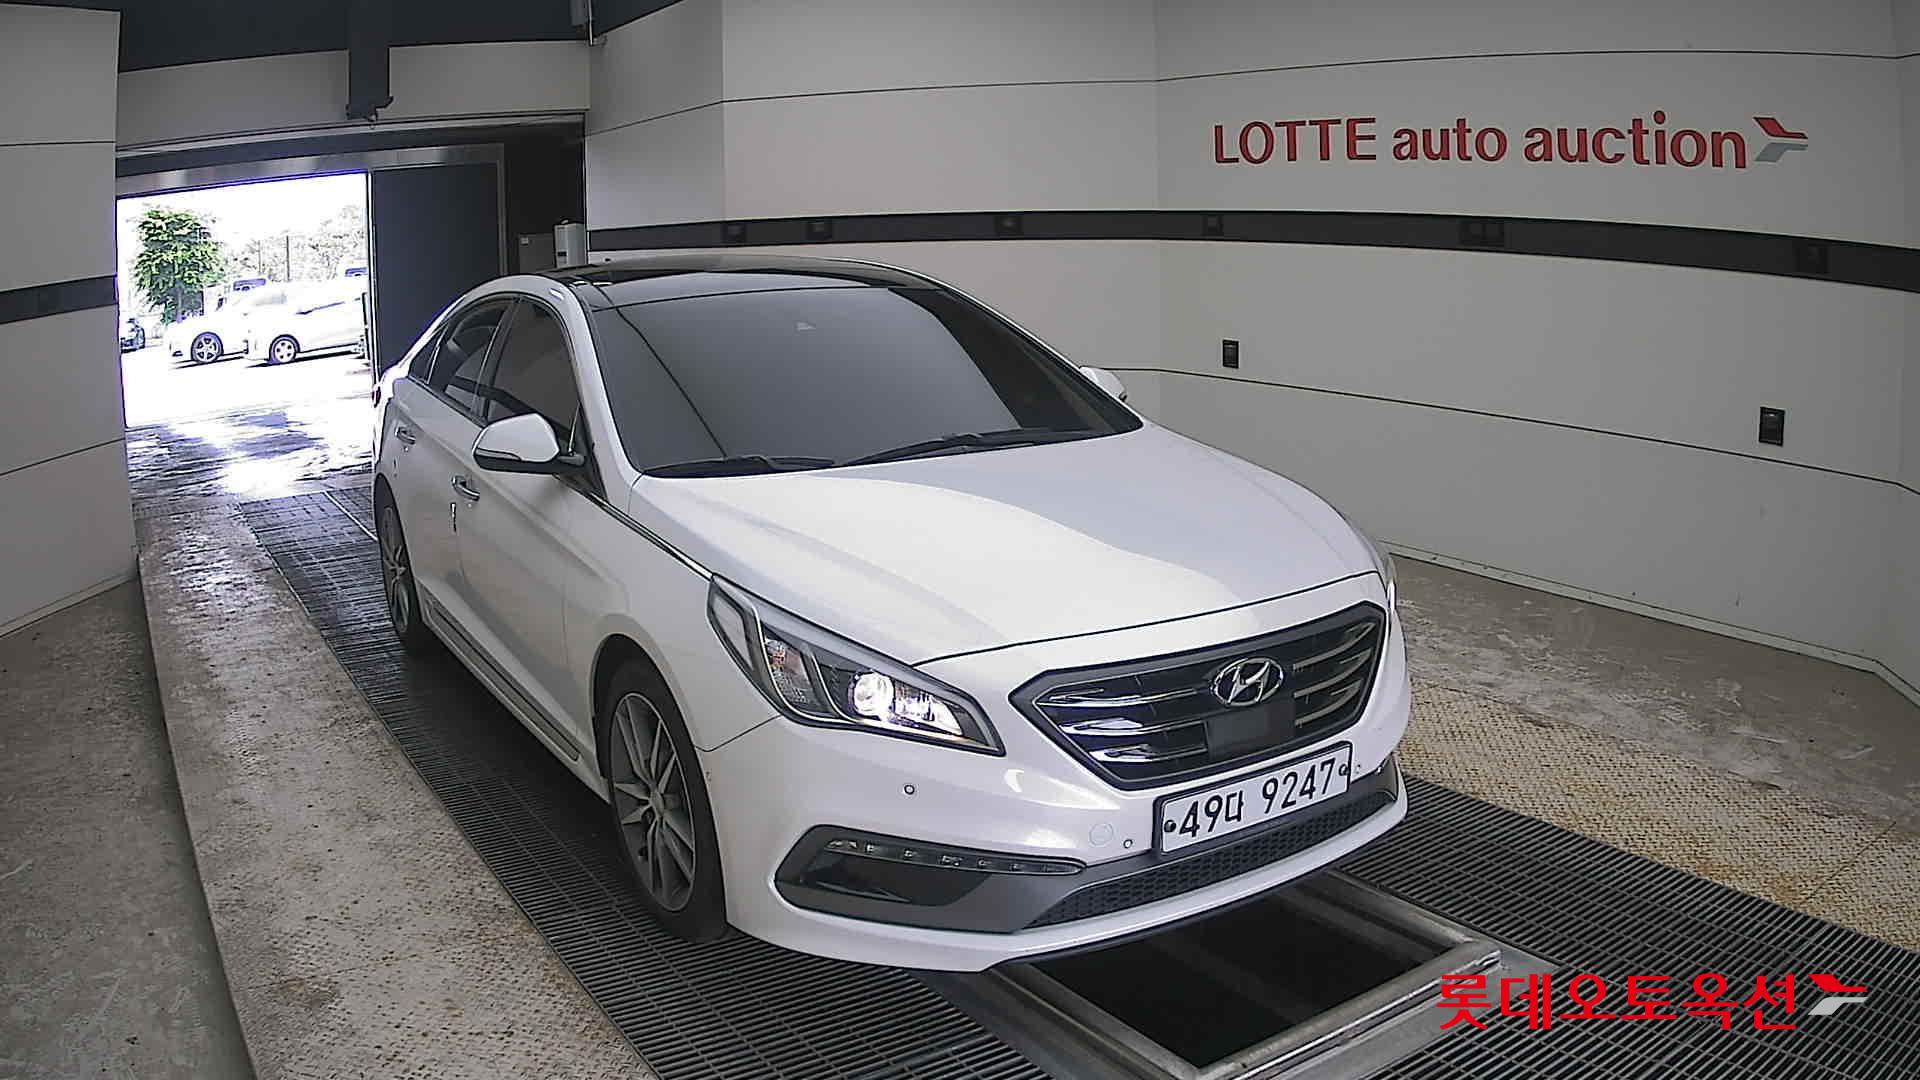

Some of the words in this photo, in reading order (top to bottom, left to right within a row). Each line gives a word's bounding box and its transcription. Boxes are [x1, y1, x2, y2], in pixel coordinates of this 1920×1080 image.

[1213, 116, 1377, 163] LOTTE
[1392, 118, 1508, 162] auto
[1523, 110, 1748, 169] auction
[1178, 789, 1245, 838] 49다
[1261, 757, 1337, 814] 9247
